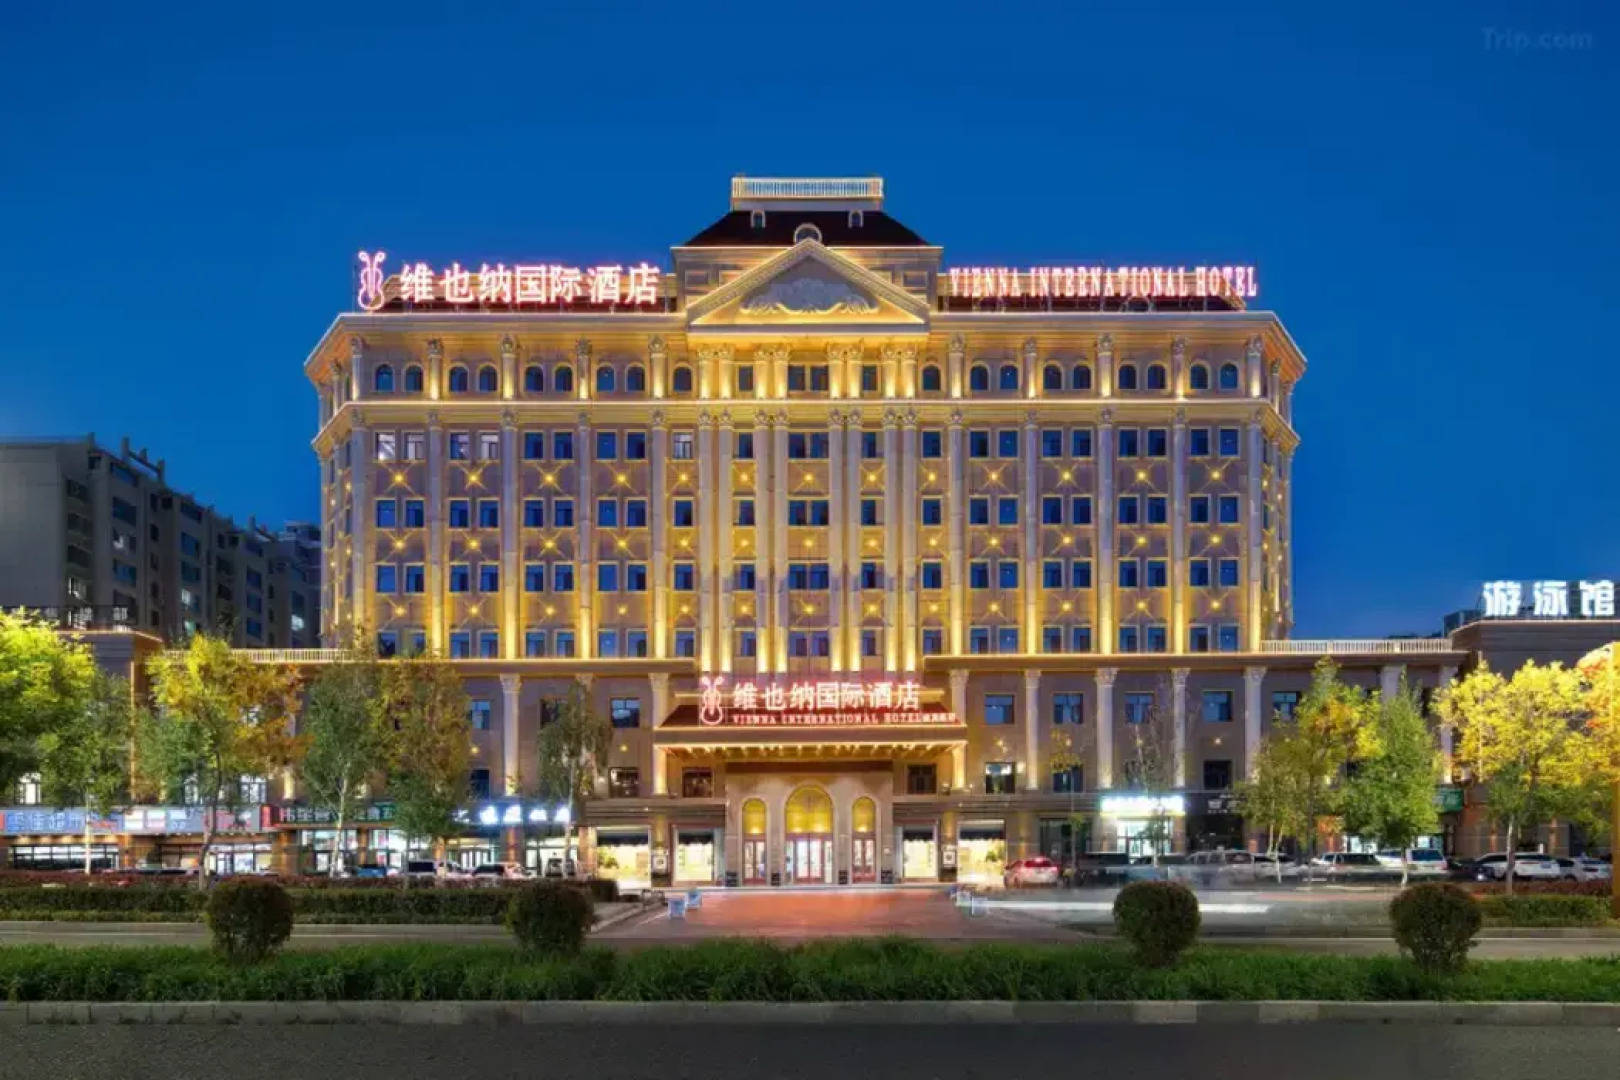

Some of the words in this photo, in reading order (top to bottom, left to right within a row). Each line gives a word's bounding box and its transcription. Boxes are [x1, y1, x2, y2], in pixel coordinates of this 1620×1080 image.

[400, 262, 660, 305] 维也纳国际酒店
[949, 266, 1020, 298] VIENNA
[1030, 266, 1187, 298] INTERNATIONAL
[1195, 265, 1258, 298] HOTEL
[1482, 579, 1615, 617] 游泳馆
[733, 681, 920, 711] 维也纳国际酒店
[732, 713, 777, 725] VIENNA
[781, 713, 879, 725] INTERNATIONAL
